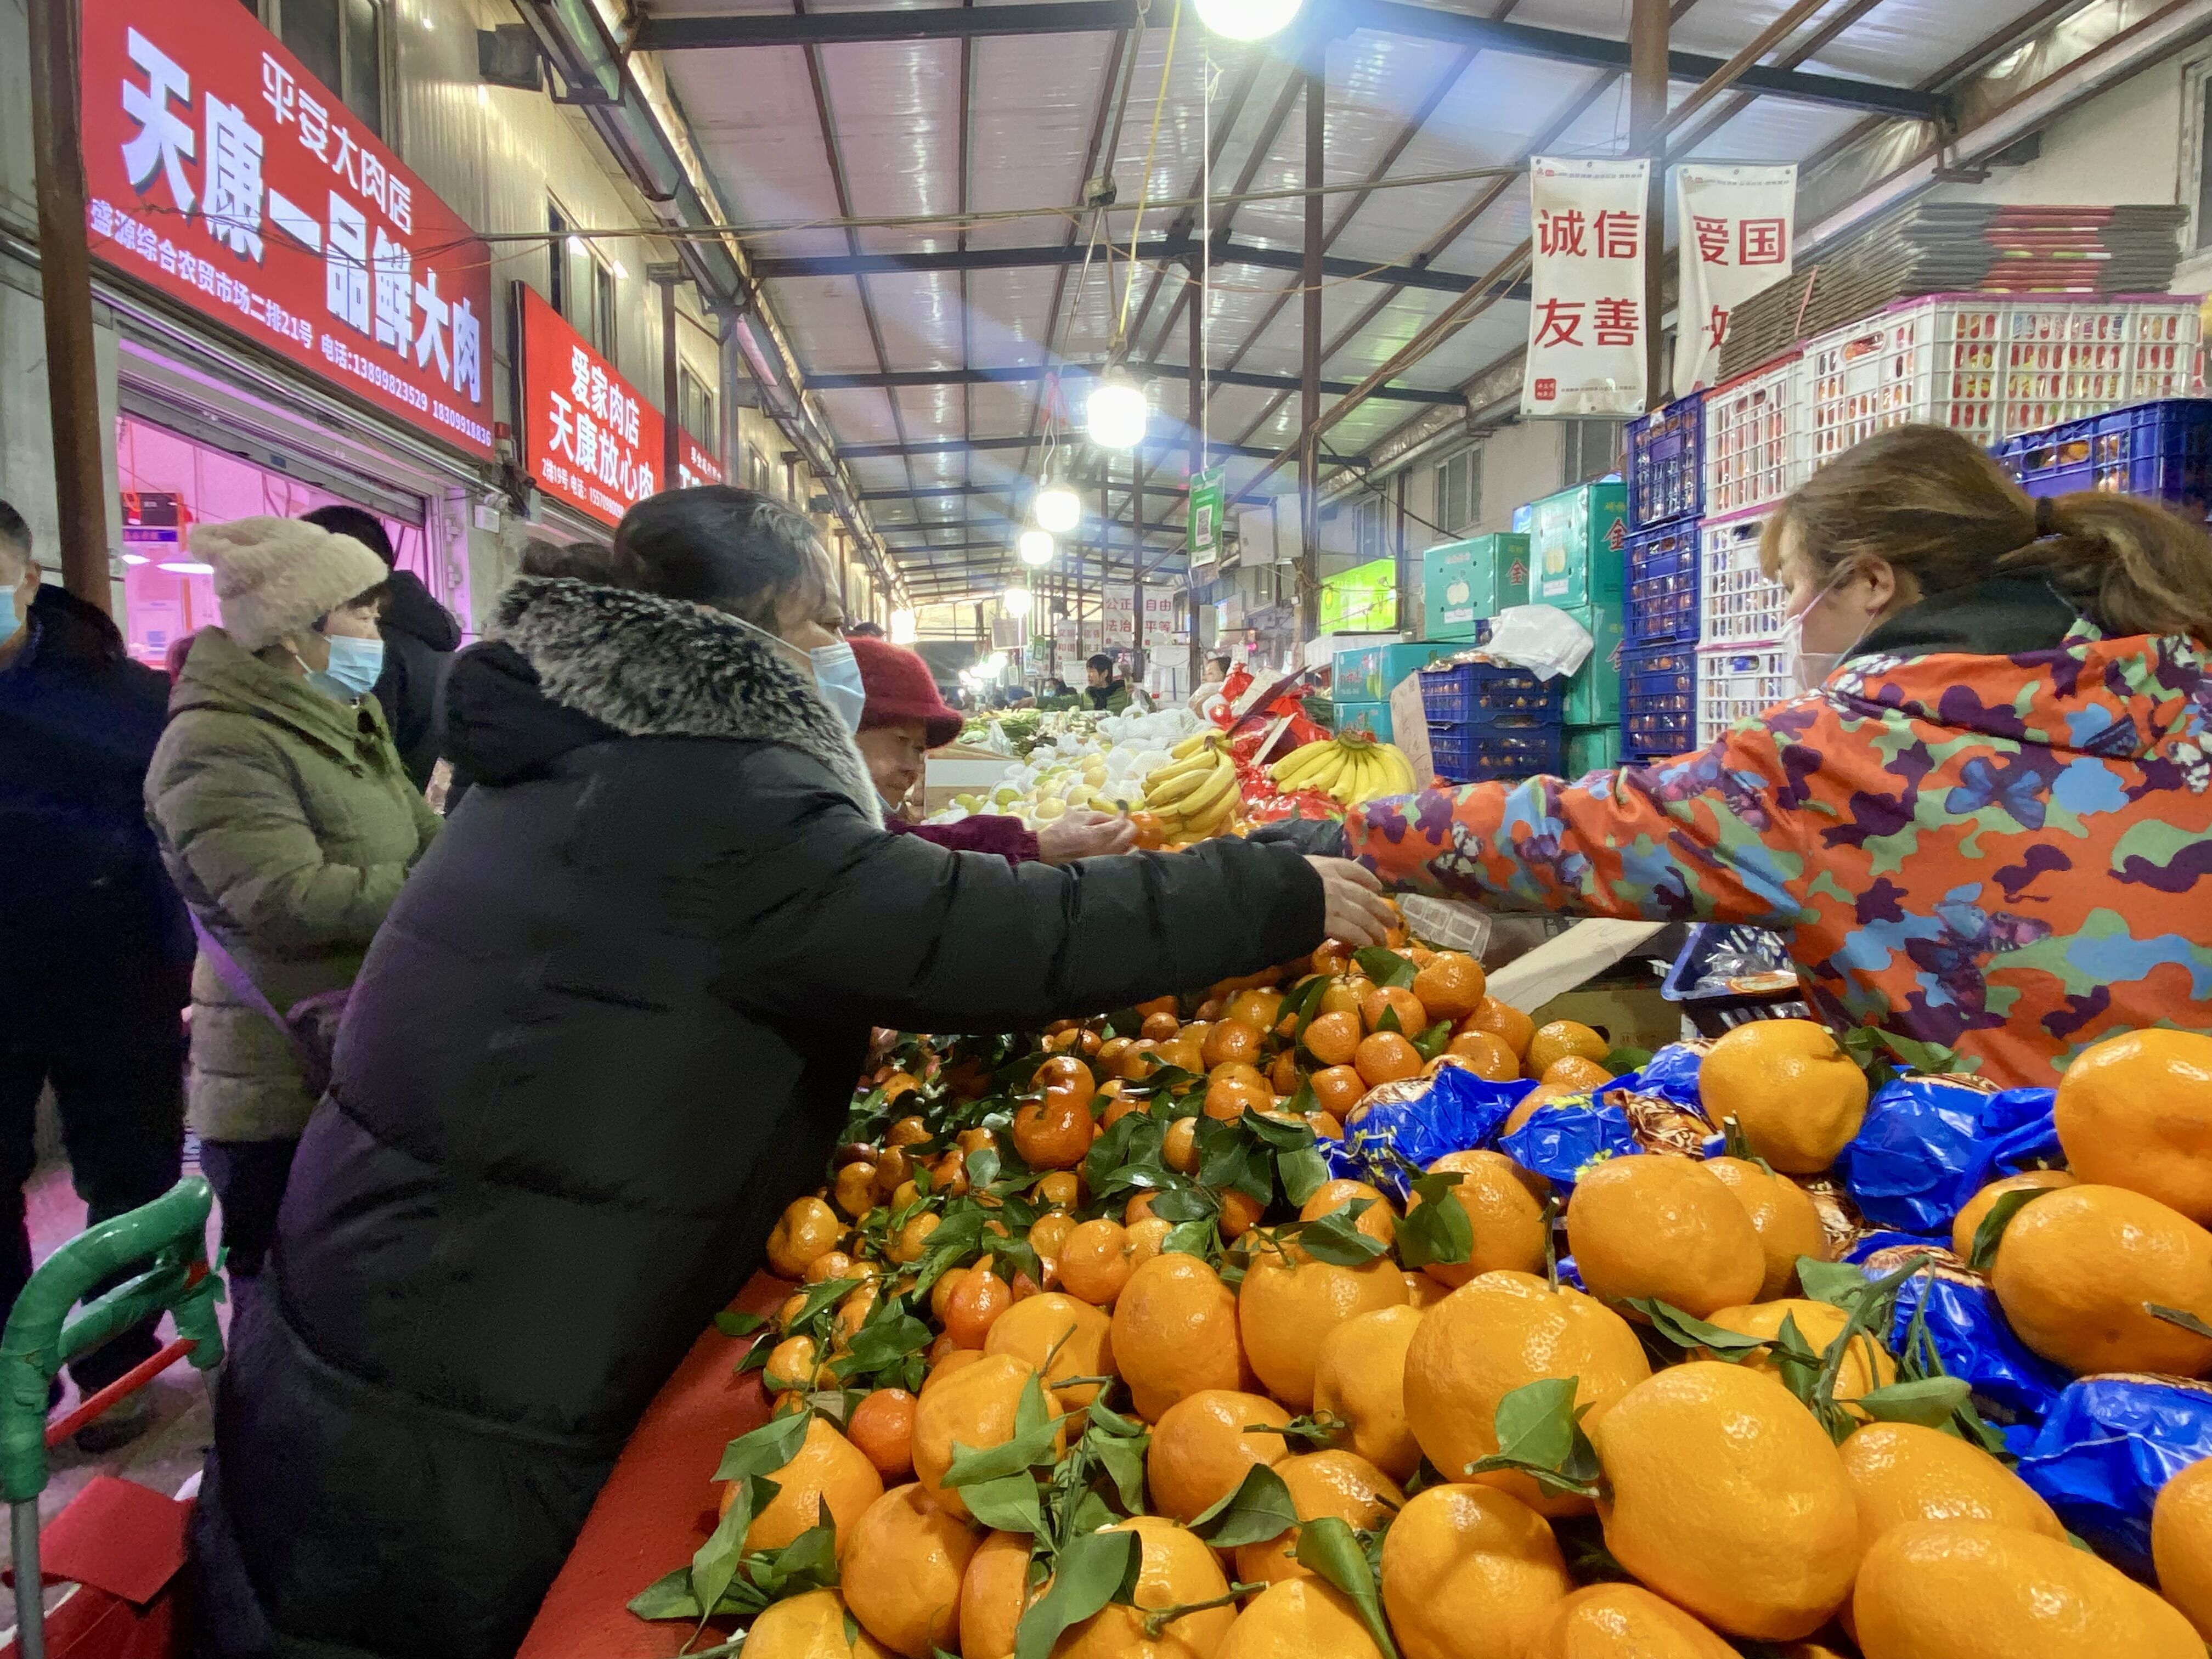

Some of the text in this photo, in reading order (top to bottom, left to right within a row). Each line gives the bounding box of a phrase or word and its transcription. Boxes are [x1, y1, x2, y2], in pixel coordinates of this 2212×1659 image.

[262, 51, 411, 235] 平安大肉店
[121, 26, 481, 404] 天康一品鲜大肉
[1538, 209, 1640, 259] 诚信
[1692, 215, 1786, 266] 爱国
[91, 198, 313, 349] 盛源综合农贸市场二排21号
[1534, 297, 1639, 348] 友善
[571, 344, 640, 449] 爱家肉店
[549, 390, 653, 500] 天康放心肉
[1105, 597, 1132, 611] 公正
[1105, 619, 1132, 633] 法治
[1144, 620, 1172, 633] 平等
[1146, 599, 1172, 612] 自由
